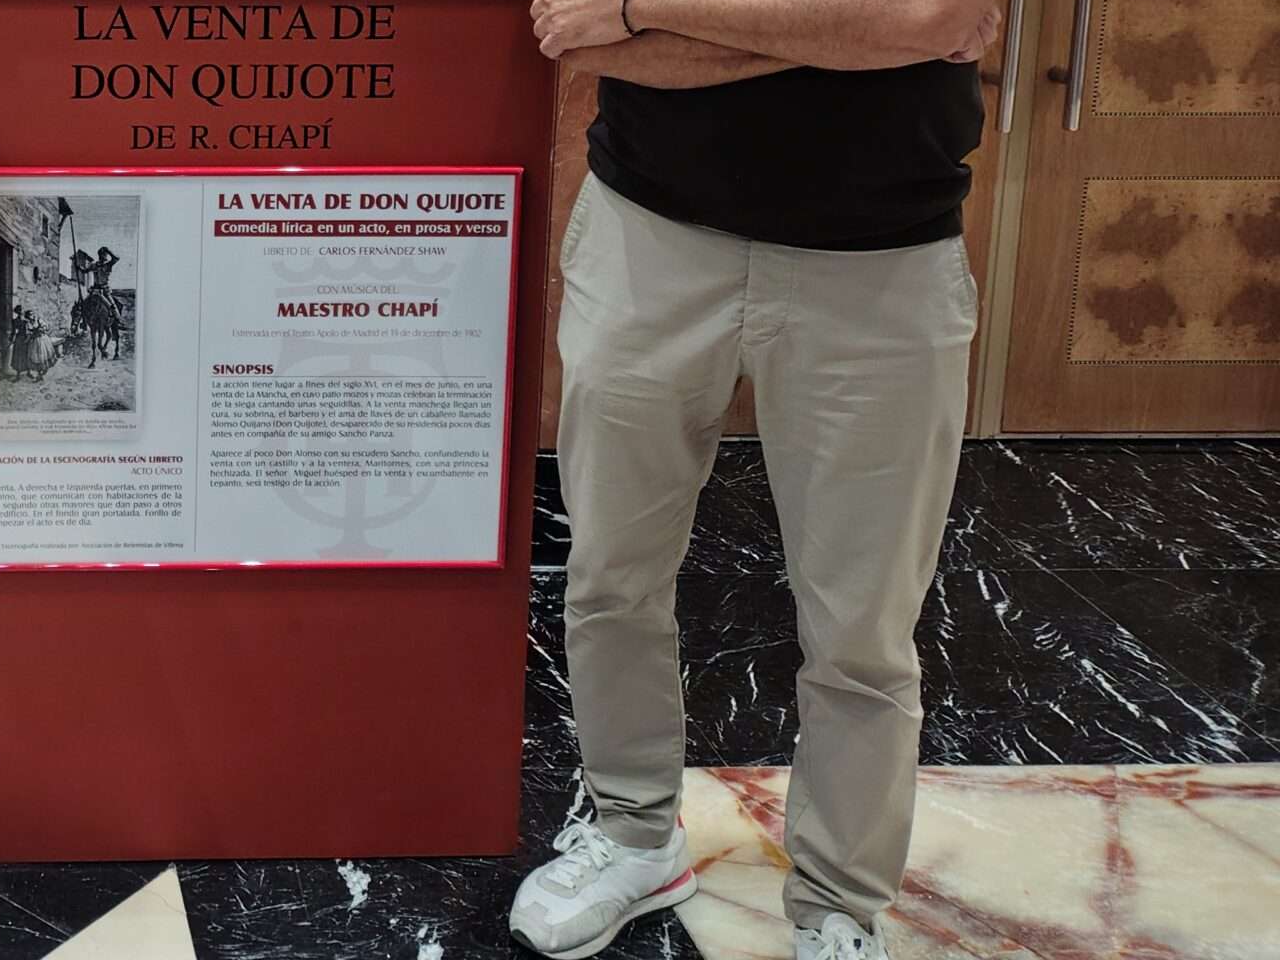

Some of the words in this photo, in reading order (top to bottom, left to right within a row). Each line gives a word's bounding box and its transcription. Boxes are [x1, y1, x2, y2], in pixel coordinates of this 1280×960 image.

[74, 5, 136, 40] LA
[151, 5, 316, 40] VENTA
[330, 5, 394, 40] DE
[72, 64, 178, 99] DON
[192, 63, 394, 107] QUIJOTE
[130, 125, 176, 150] DE
[189, 125, 218, 150] R.
[228, 118, 334, 150] CHAPÍ
[218, 193, 245, 210] LA
[252, 193, 320, 210] VENTA
[328, 193, 356, 210] DE
[363, 193, 412, 211] DON
[419, 193, 506, 211] QUIJOTE
[220, 222, 277, 235] Comedia
[281, 222, 313, 235] lírica
[317, 222, 333, 235] en
[338, 222, 354, 235] un
[358, 222, 389, 235] acto,
[394, 222, 411, 235] en
[415, 222, 451, 235] prosa
[454, 222, 462, 235] y
[466, 222, 501, 235] verso
[318, 246, 356, 257] CARLOS
[358, 246, 416, 257] FERNÁNDEZ
[417, 246, 447, 257] SHAW
[276, 299, 372, 318] MAESTRO
[379, 298, 438, 317] CHAPÍ
[212, 364, 274, 374] SINOPSIS
[26, 455, 38, 464] DE
[40, 455, 51, 464] LA
[52, 455, 116, 464] ESCENOGRAFÍA
[117, 455, 146, 464] SEGÚN
[148, 455, 183, 464] LIBRETO
